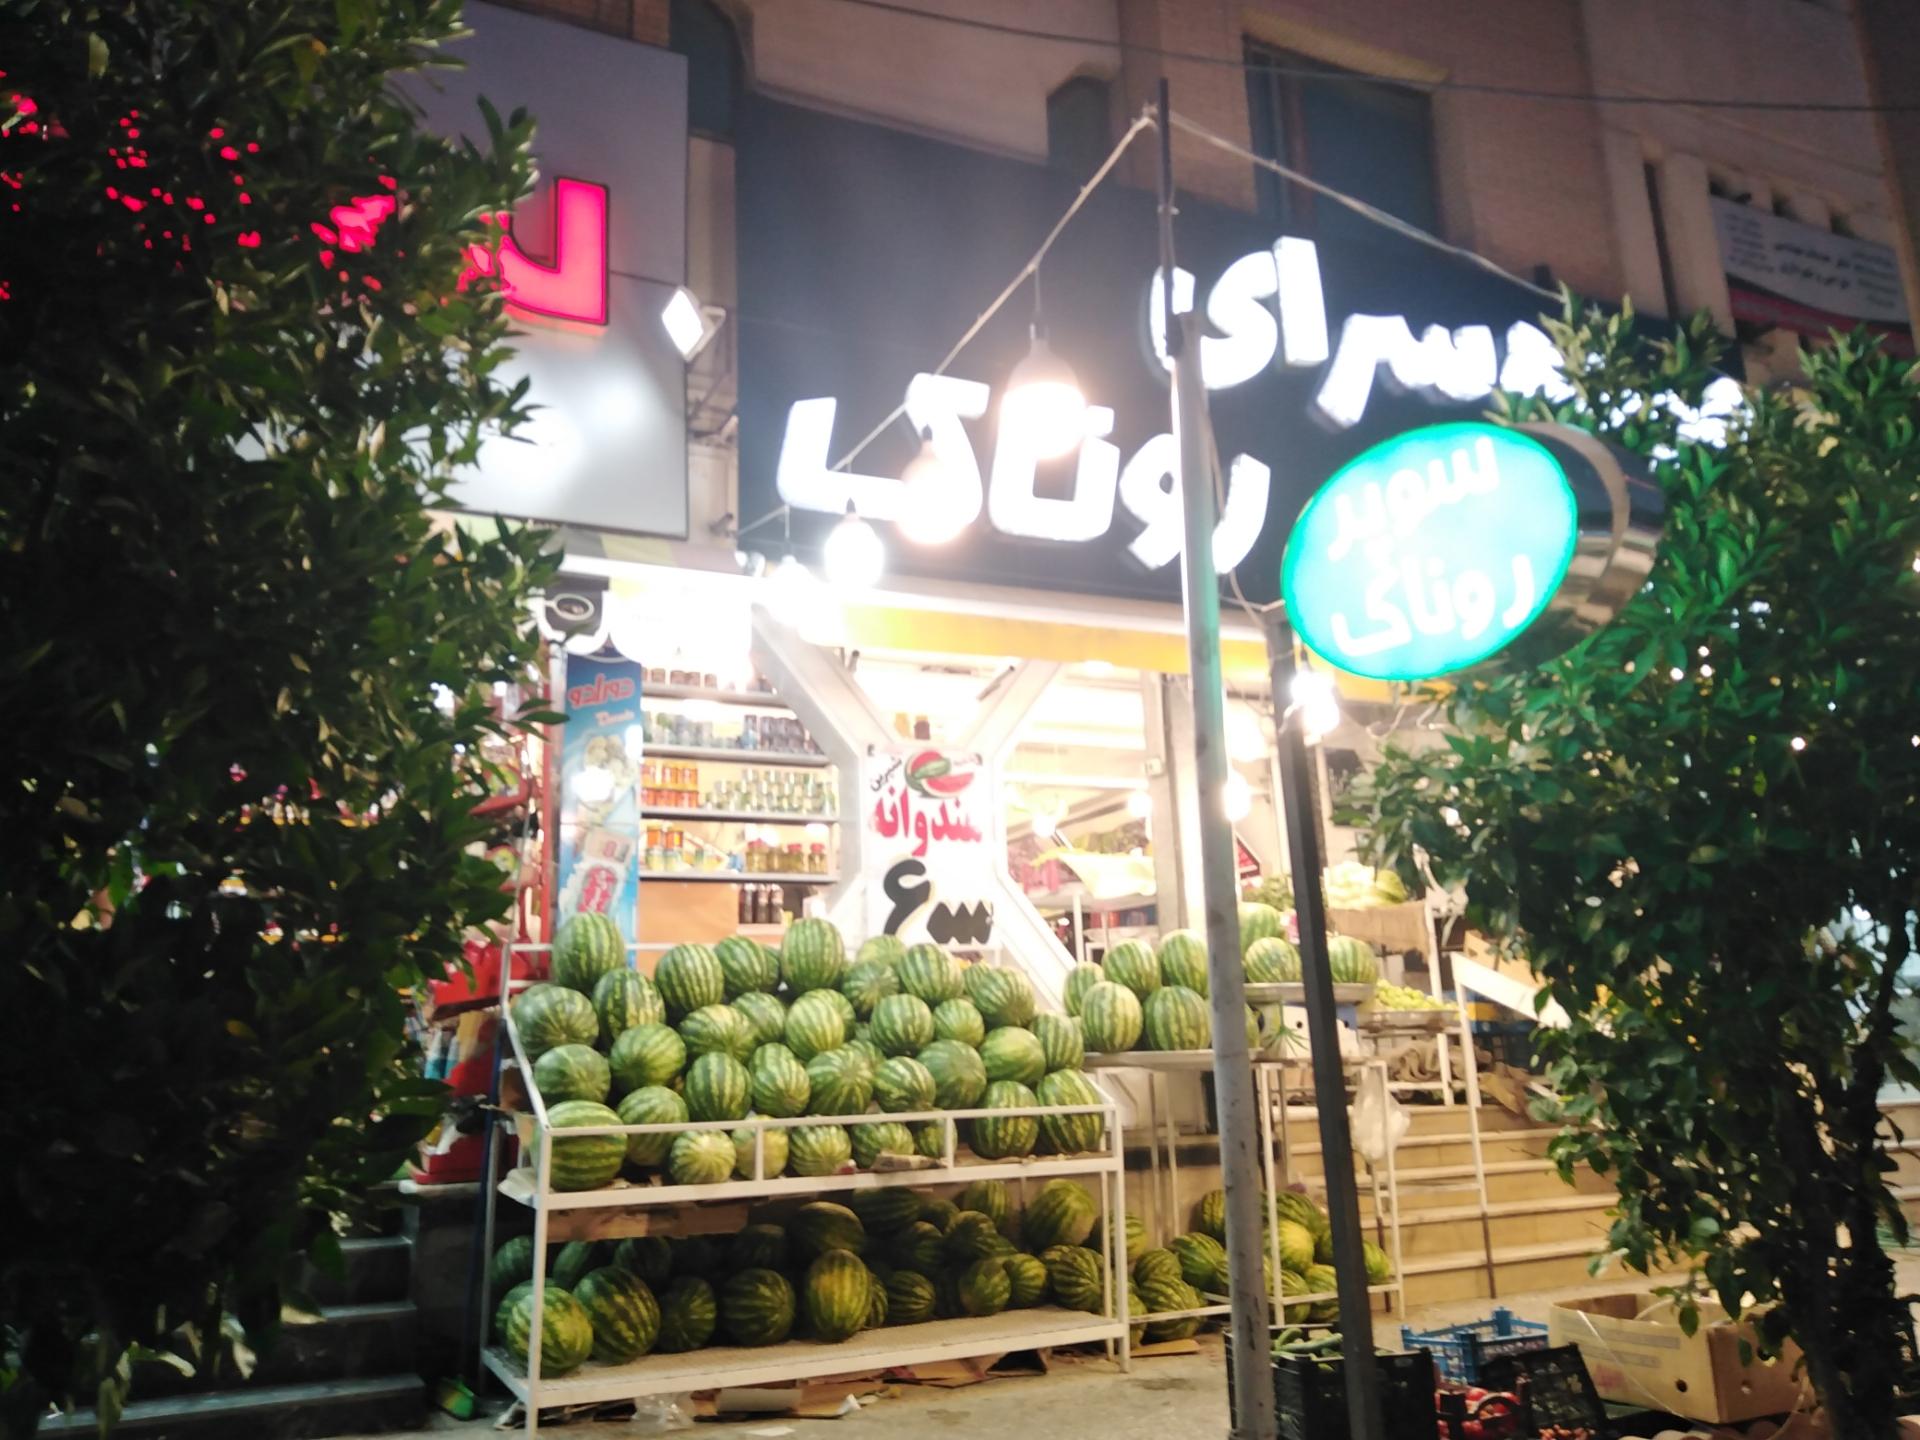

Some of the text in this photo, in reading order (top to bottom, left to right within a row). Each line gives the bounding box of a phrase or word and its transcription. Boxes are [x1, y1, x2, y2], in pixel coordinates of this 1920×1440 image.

[1149, 235, 1498, 430] سرای
[1327, 436, 1500, 566] سوپر
[1330, 552, 1535, 657] روناک
